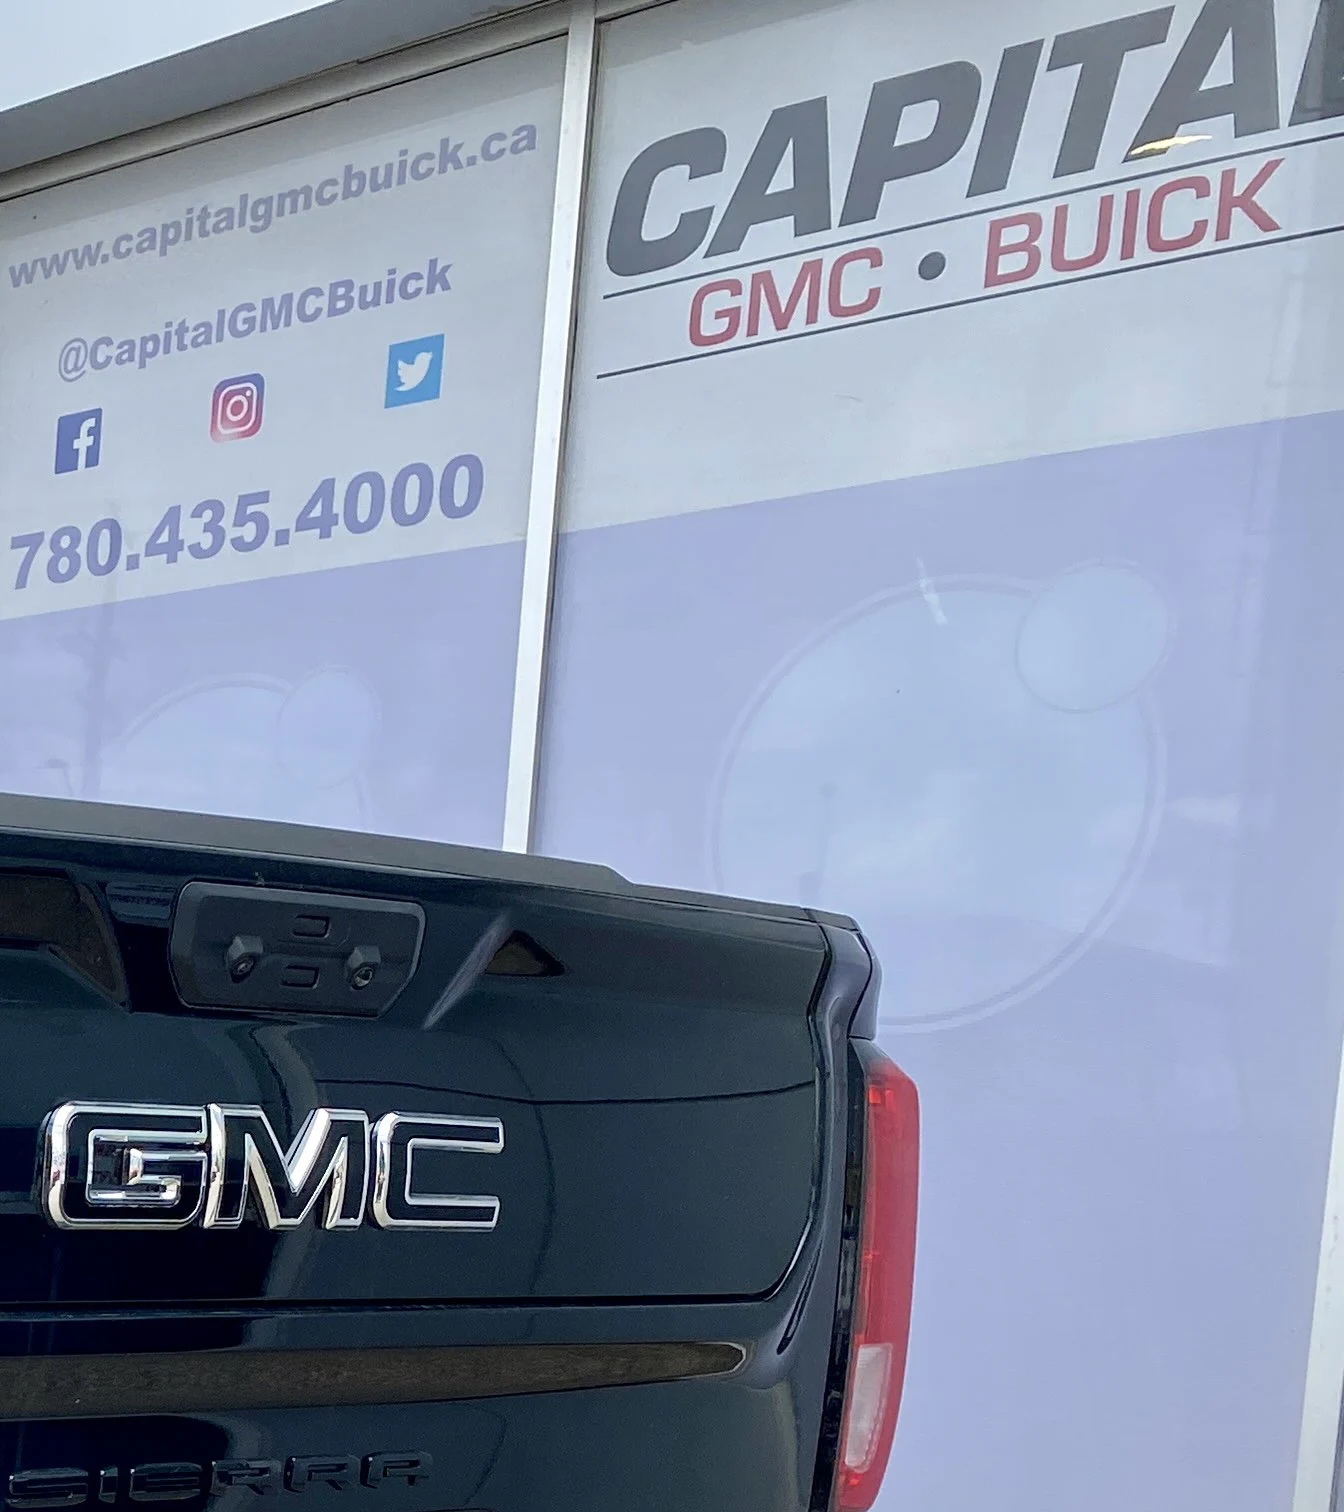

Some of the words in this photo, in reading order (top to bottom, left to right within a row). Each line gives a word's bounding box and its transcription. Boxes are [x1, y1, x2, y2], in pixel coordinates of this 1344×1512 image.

[8, 123, 538, 288] www.capitalgmcbuick.ca
[688, 246, 884, 347] GMC
[983, 157, 1286, 289] BUICK
[58, 258, 454, 382] @CapitalGMCBuick
[9, 454, 484, 591] 780.435.4000
[40, 1101, 505, 1232] GMC
[6, 1450, 433, 1509] SIERRA
